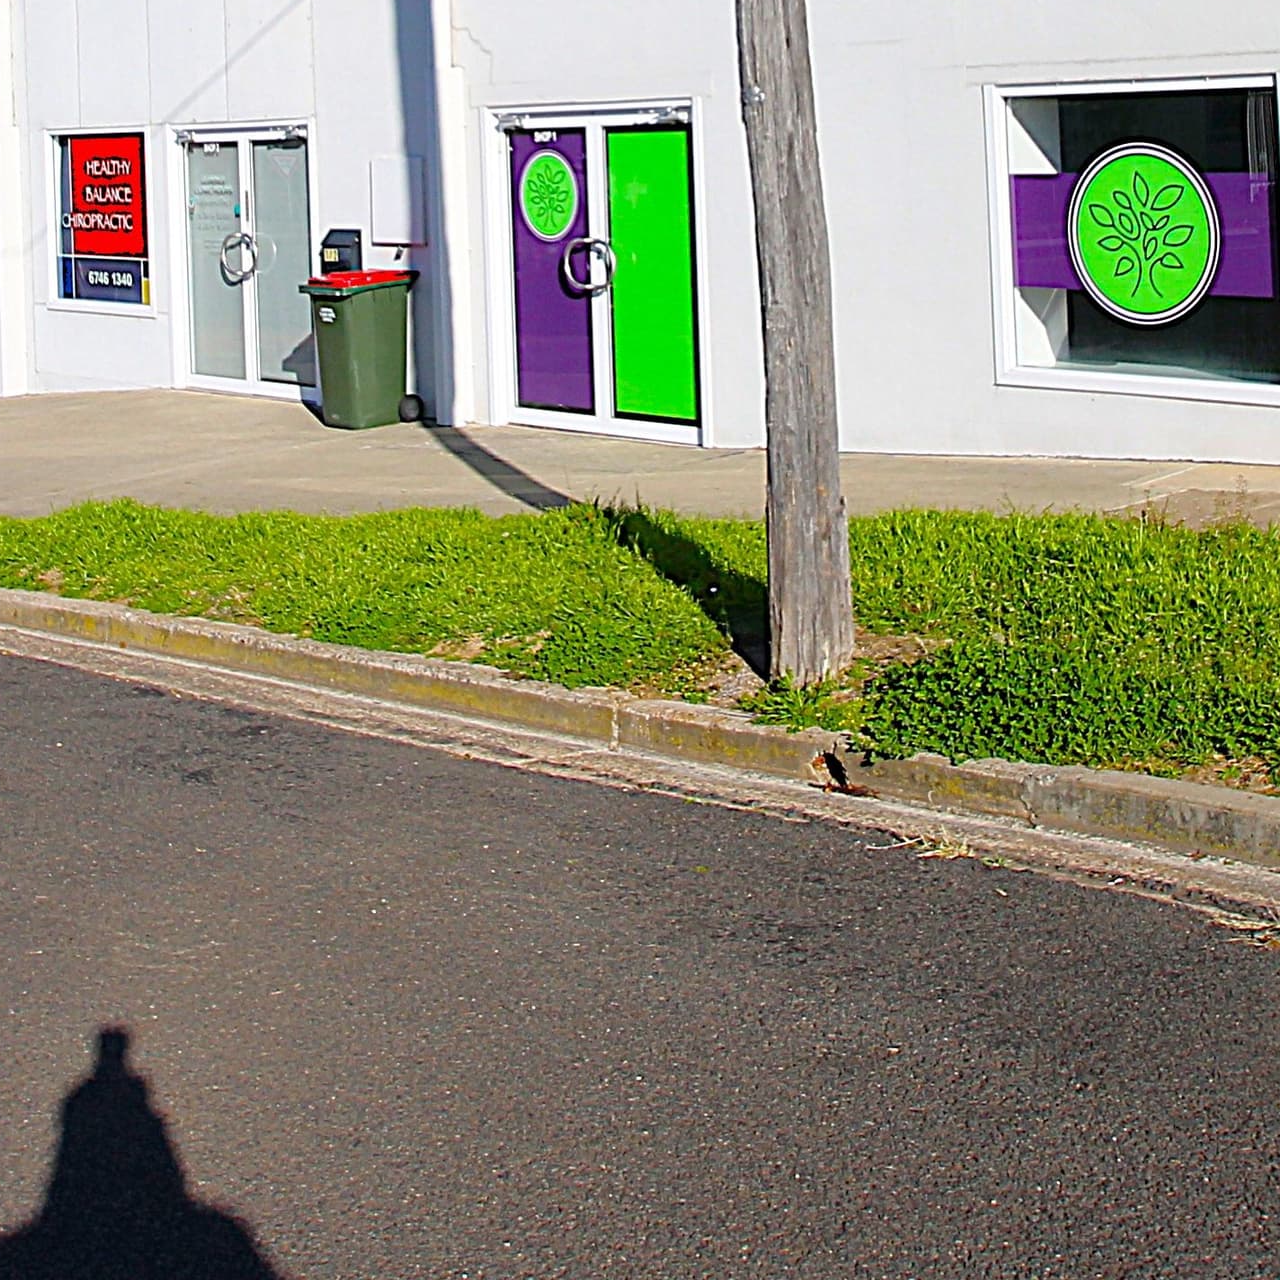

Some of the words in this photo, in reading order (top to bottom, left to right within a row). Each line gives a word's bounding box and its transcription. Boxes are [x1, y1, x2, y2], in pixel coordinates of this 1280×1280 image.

[86, 159, 131, 176] HEALTHY
[85, 186, 132, 203] BALANCE
[62, 212, 133, 231] CHIROPRACTIC
[111, 271, 133, 287] 1340
